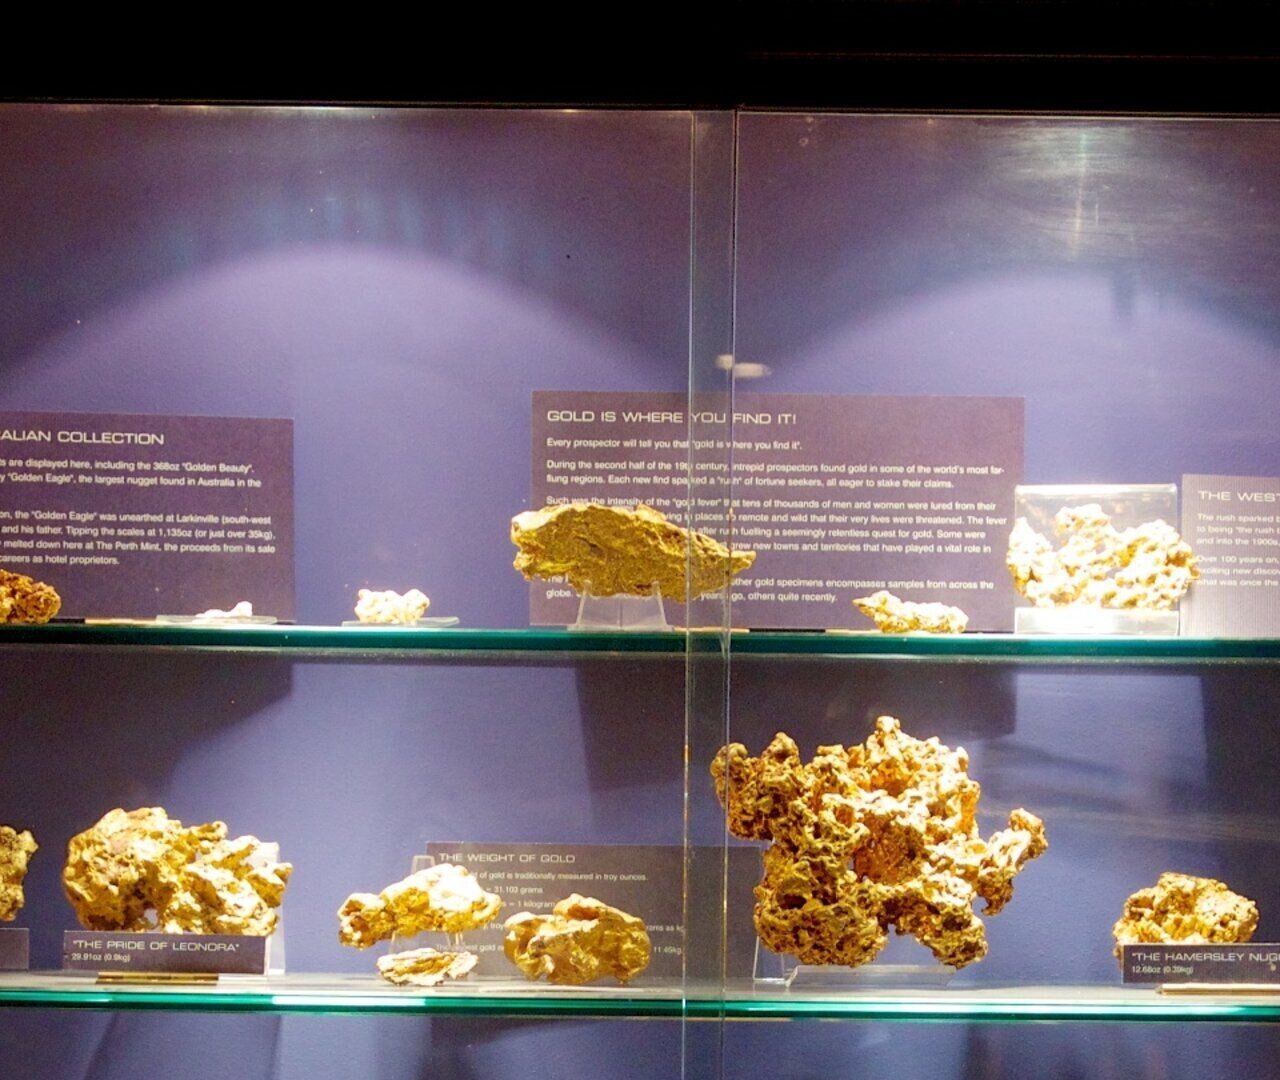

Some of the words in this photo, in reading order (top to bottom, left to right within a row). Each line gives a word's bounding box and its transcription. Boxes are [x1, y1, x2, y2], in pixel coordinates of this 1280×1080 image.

[546, 410, 596, 422] GOLD
[600, 411, 617, 422] IS
[621, 411, 683, 423] WHERE
[687, 412, 727, 423] YOU
[731, 412, 772, 424] FIND
[777, 413, 797, 424] IT!
[56, 430, 165, 445] COLLECTION
[1200, 491, 1230, 501] THE
[438, 853, 463, 862] THE
[466, 853, 515, 863] WEIGHT
[518, 854, 536, 863] OF
[539, 854, 576, 863] GOLD
[105, 940, 146, 950] PRIDE
[148, 941, 168, 950] OF
[1164, 952, 1245, 964] HAMERSLEY
